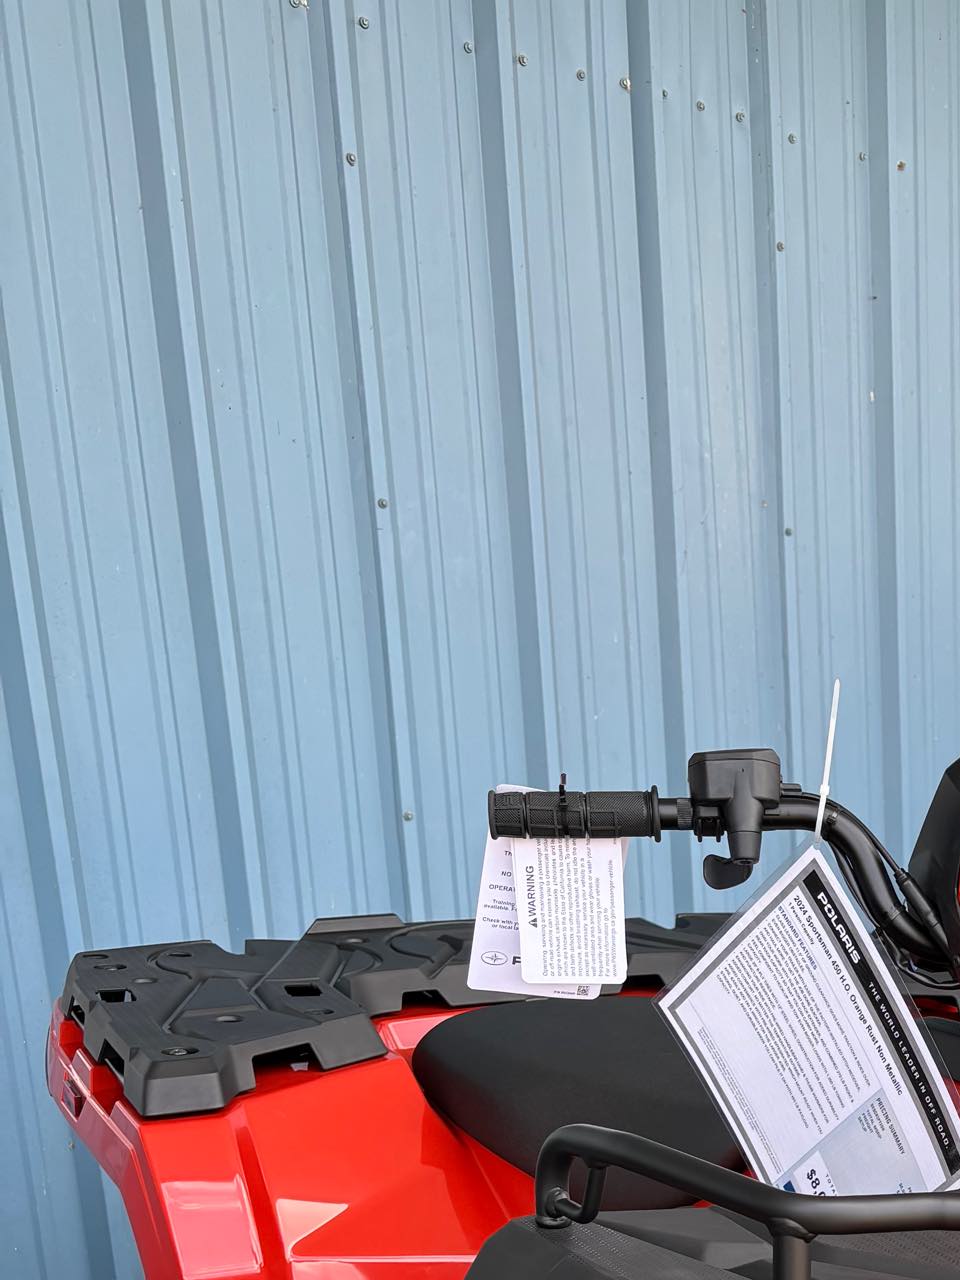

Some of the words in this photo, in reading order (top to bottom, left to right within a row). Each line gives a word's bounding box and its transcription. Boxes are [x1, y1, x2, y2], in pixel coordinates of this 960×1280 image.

[525, 865, 536, 916] WARNING
[777, 904, 799, 939] STANDARD
[796, 937, 817, 970] FEATURES
[790, 904, 802, 924] Person
[799, 922, 815, 946] Capacity
[817, 891, 860, 965] POLARIS
[793, 893, 808, 916] 2024
[804, 914, 834, 961] Sportsman
[830, 958, 842, 976] 450
[838, 973, 852, 994] H.O.
[848, 992, 868, 1026] Orange
[865, 1023, 879, 1045] Rust
[875, 1043, 888, 1064] Non
[884, 1061, 904, 1096] Metallic
[868, 981, 882, 996] THE
[880, 1003, 900, 1040] WORLD
[899, 1040, 920, 1079] LEADER
[918, 1081, 926, 1094] IN
[925, 1096, 936, 1114] OFF
[935, 1118, 950, 1149] ROAD.
[875, 1096, 891, 1125] PRICING
[888, 1123, 905, 1156] SUMMARY
[826, 1174, 837, 1196] TOTA
